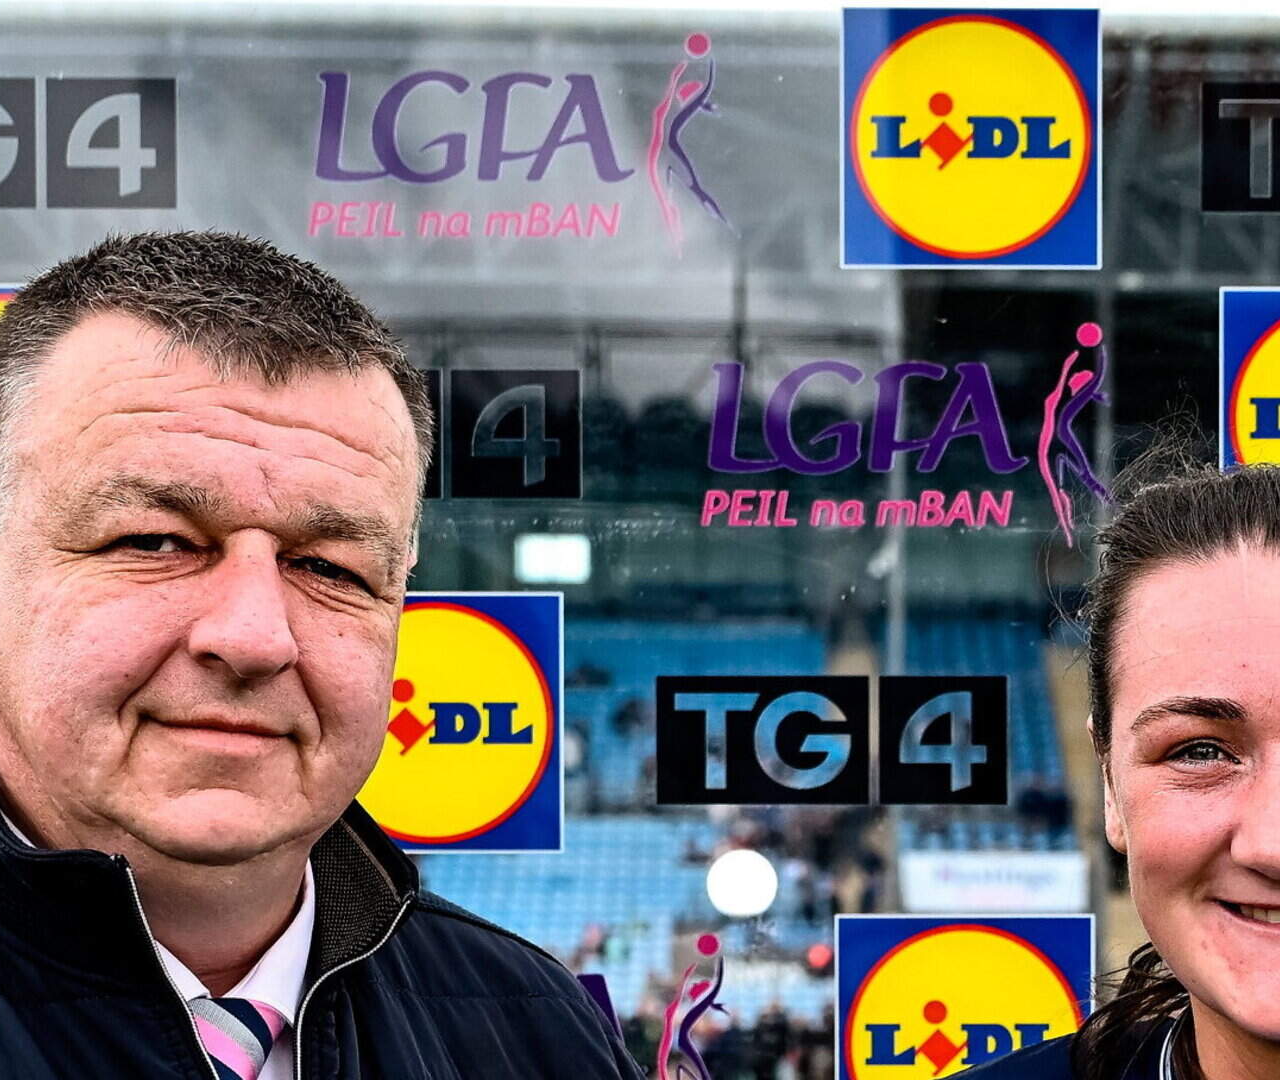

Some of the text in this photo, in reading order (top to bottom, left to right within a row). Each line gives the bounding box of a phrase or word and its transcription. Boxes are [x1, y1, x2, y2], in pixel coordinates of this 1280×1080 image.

[314, 70, 633, 184] LGFA
[309, 203, 621, 238] PEIL na mBAN
[707, 361, 1030, 474] LGFA
[701, 490, 1013, 527] PEIL na mBAN
